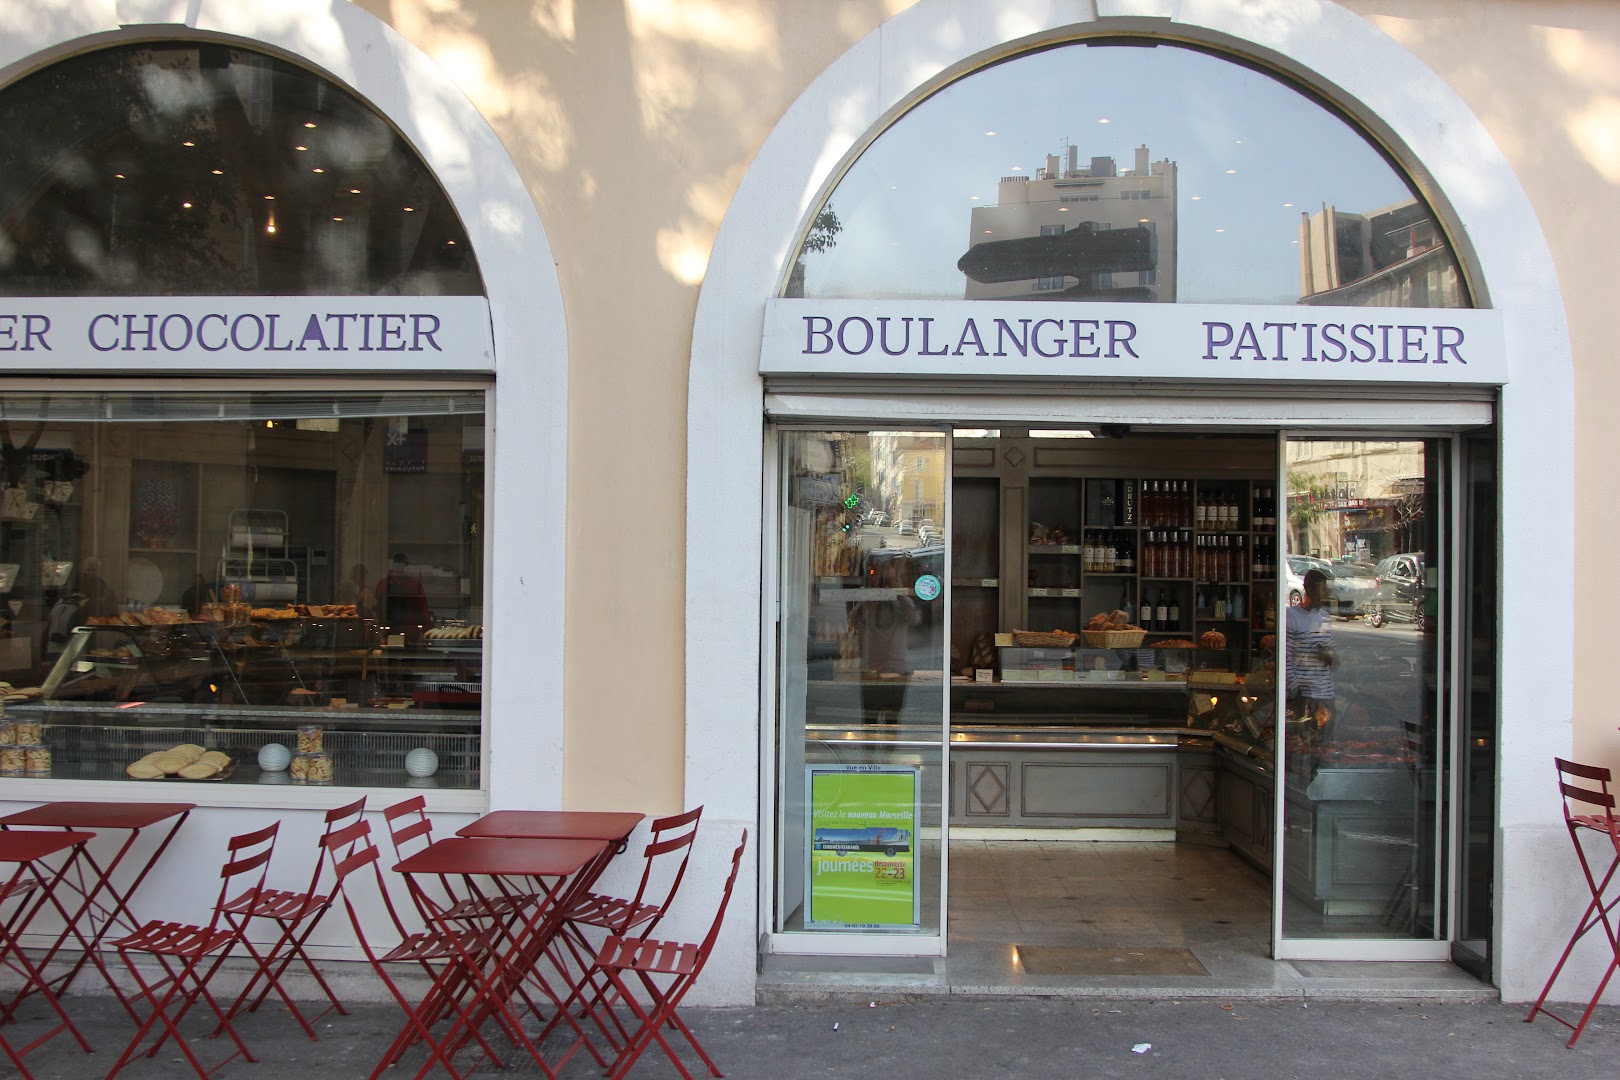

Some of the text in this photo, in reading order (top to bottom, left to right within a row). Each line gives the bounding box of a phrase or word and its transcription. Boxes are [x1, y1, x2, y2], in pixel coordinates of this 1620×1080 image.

[88, 313, 443, 352] CHOCOLATIER
[801, 316, 1468, 365] BOULANGER PATISSIER
[814, 810, 913, 819] Visitez le nouveau Marseille
[816, 856, 906, 876] journées découverte
[875, 868, 905, 880] 22-23
